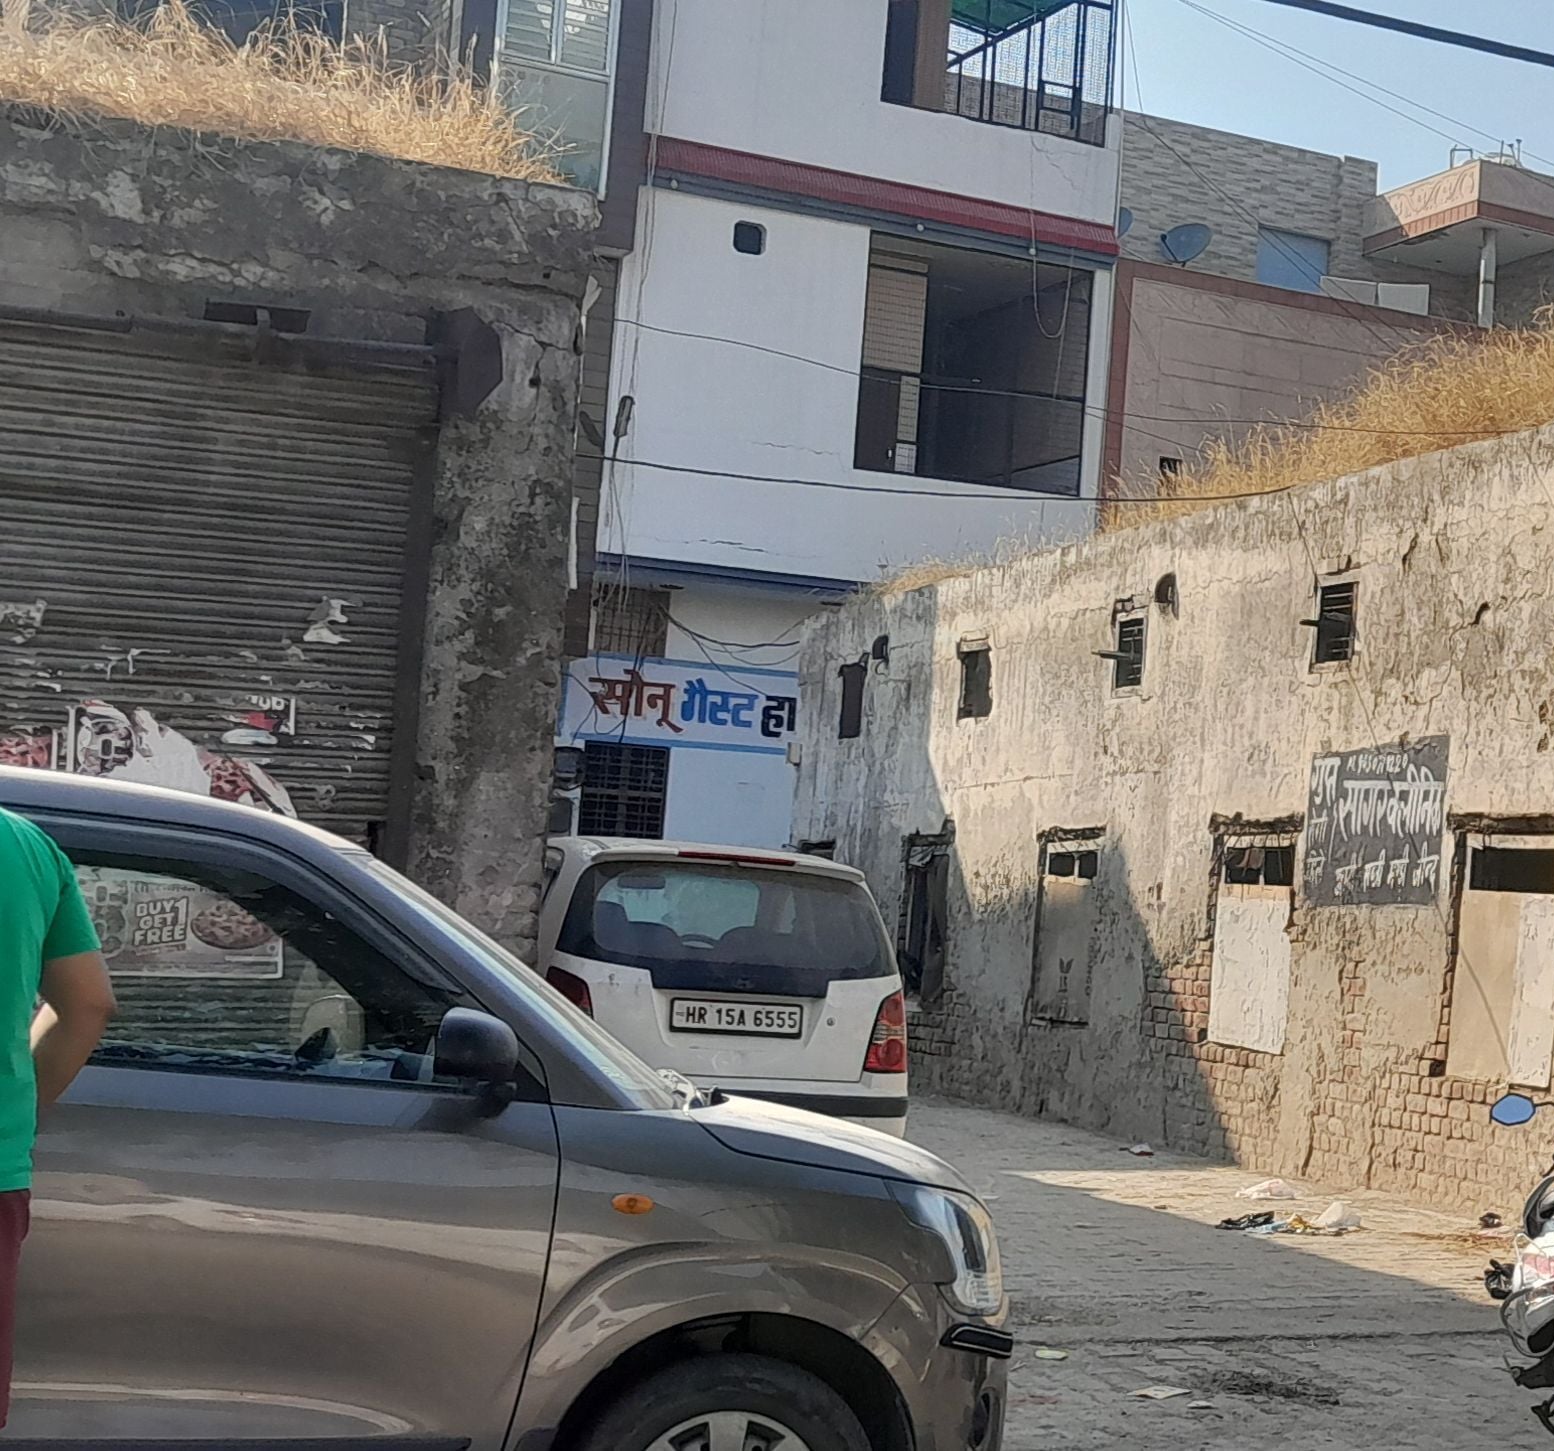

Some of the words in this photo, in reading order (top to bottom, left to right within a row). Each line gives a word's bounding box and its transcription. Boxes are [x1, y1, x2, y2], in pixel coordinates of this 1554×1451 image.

[589, 669, 683, 733] सोनू
[681, 678, 758, 728] गैस्ट
[136, 900, 173, 916] BUY
[139, 913, 174, 928] GET
[134, 926, 185, 945] FREE
[685, 1006, 706, 1024] HR
[716, 1008, 746, 1026] 15A
[753, 1011, 797, 1029] 6555
